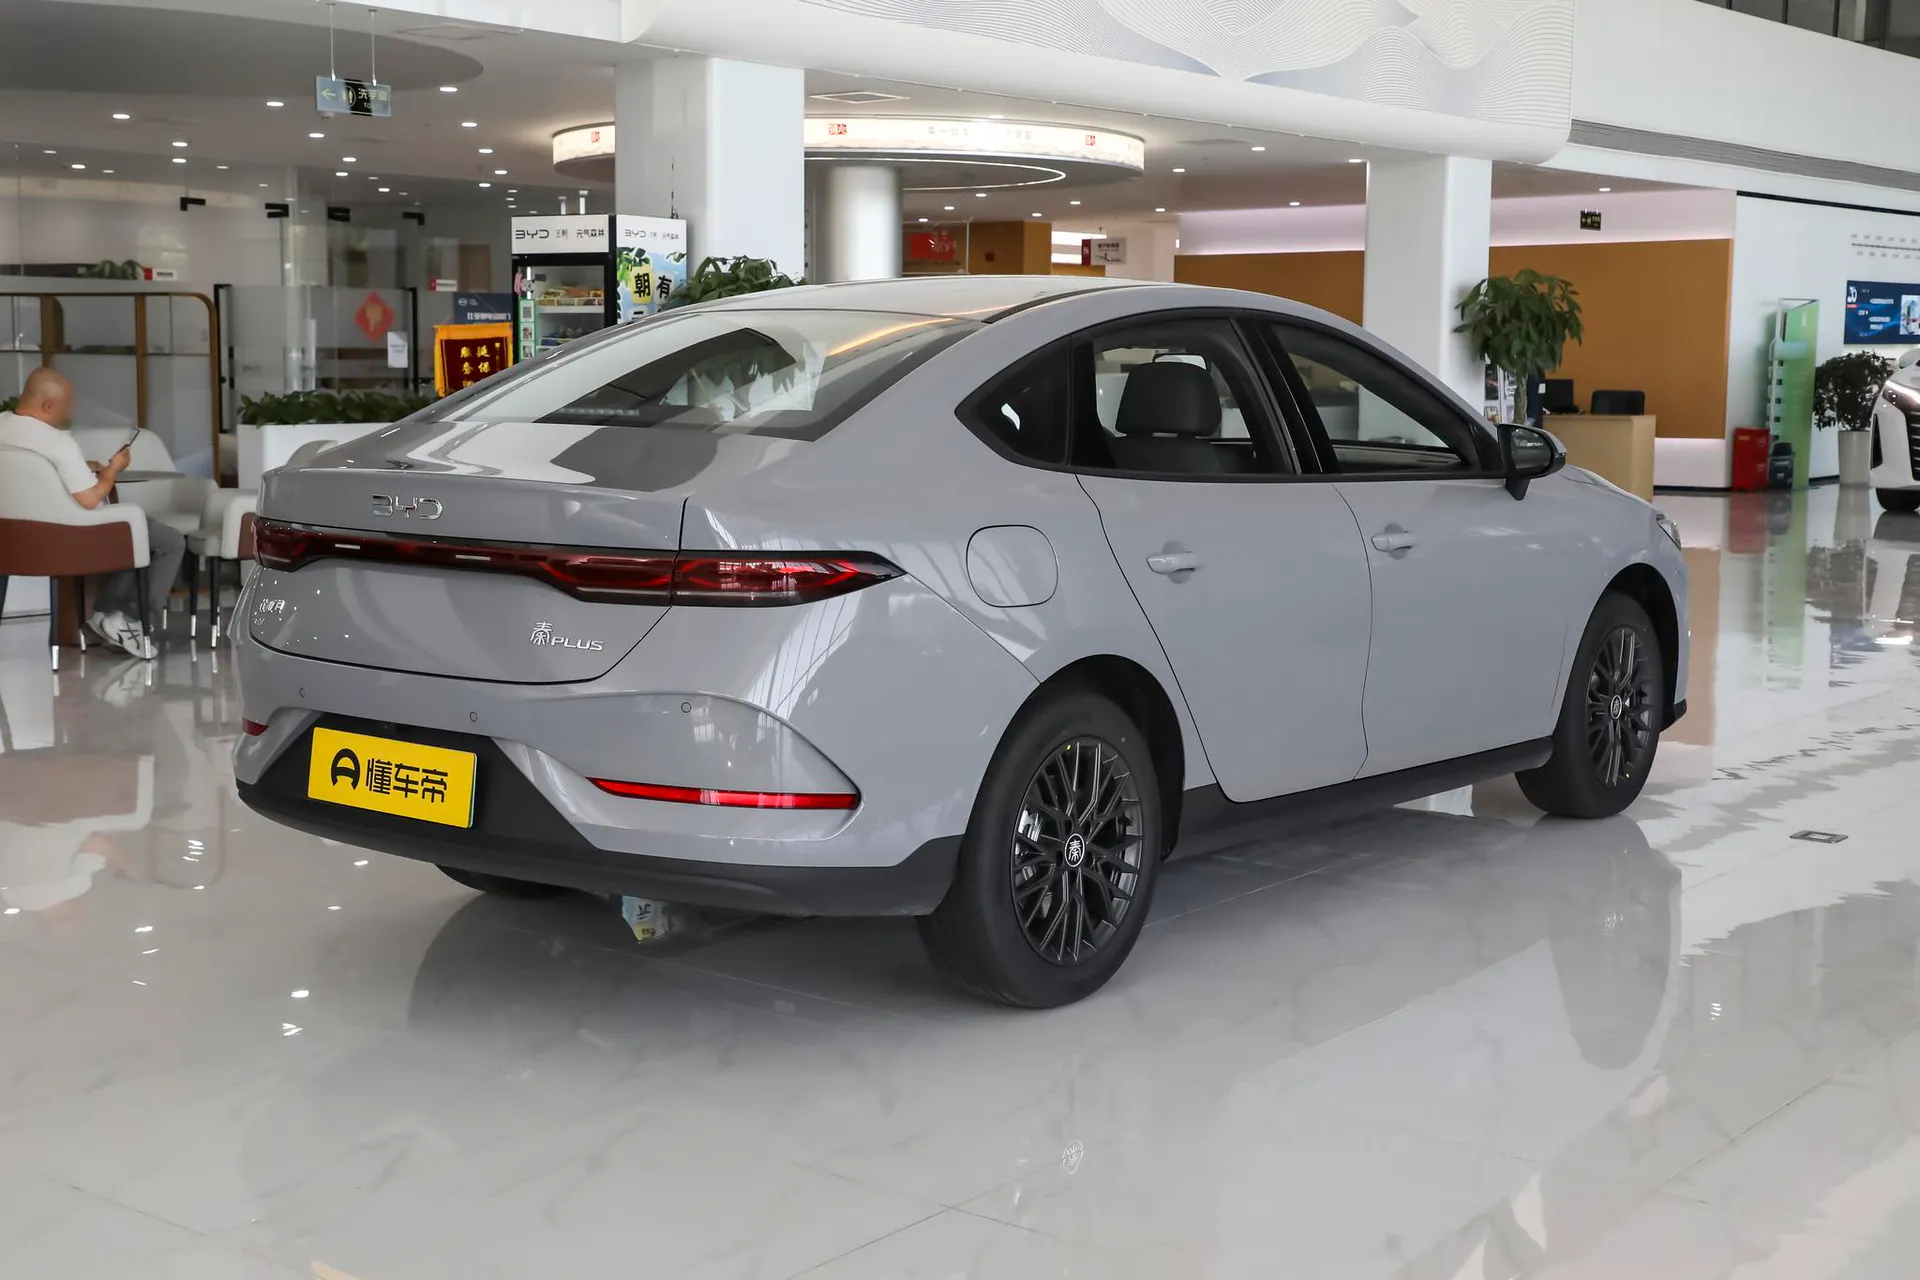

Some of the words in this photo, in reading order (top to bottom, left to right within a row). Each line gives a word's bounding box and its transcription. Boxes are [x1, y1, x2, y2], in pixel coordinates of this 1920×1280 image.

[515, 229, 550, 240] BYD
[576, 229, 605, 239] 元气森林
[624, 228, 647, 238] BYD
[372, 493, 443, 520] BYD
[366, 758, 449, 803] 懂车帝
[1068, 839, 1082, 862] 秦
